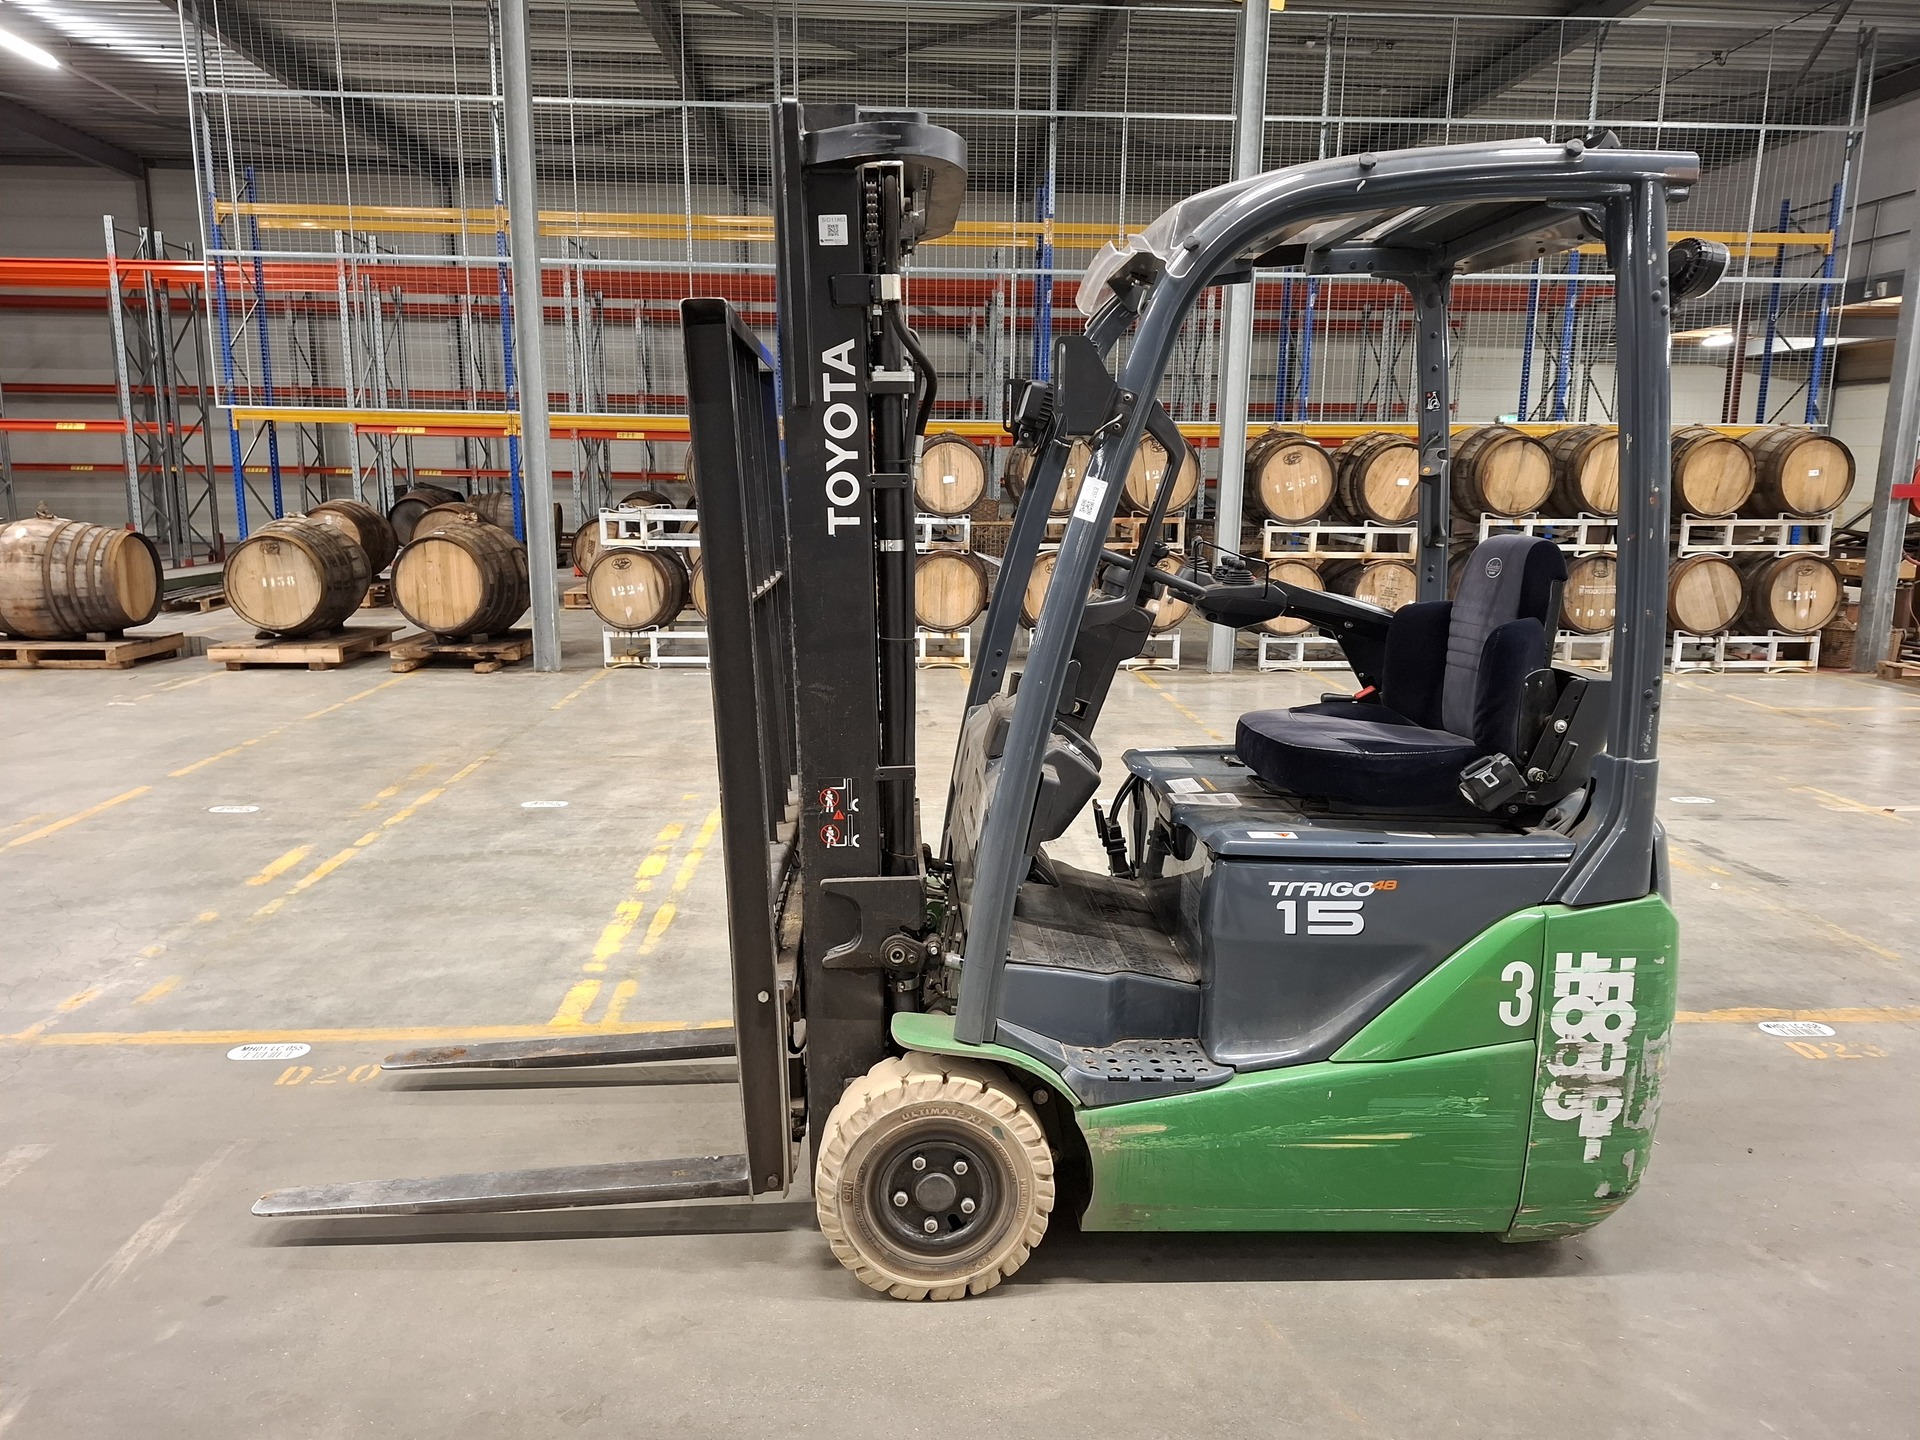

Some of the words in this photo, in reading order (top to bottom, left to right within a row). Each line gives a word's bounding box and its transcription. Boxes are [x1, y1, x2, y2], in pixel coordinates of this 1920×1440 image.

[821, 338, 861, 536] TOYOTA
[1787, 589, 1817, 601] 1218
[1268, 881, 1376, 897] TRAIGO
[1370, 879, 1398, 891] 48
[1276, 900, 1366, 936] 15
[1498, 960, 1536, 1027] 3
[273, 1064, 382, 1086] D20
[901, 1107, 965, 1121] ULTIMATE
[842, 1180, 853, 1203] GRI
